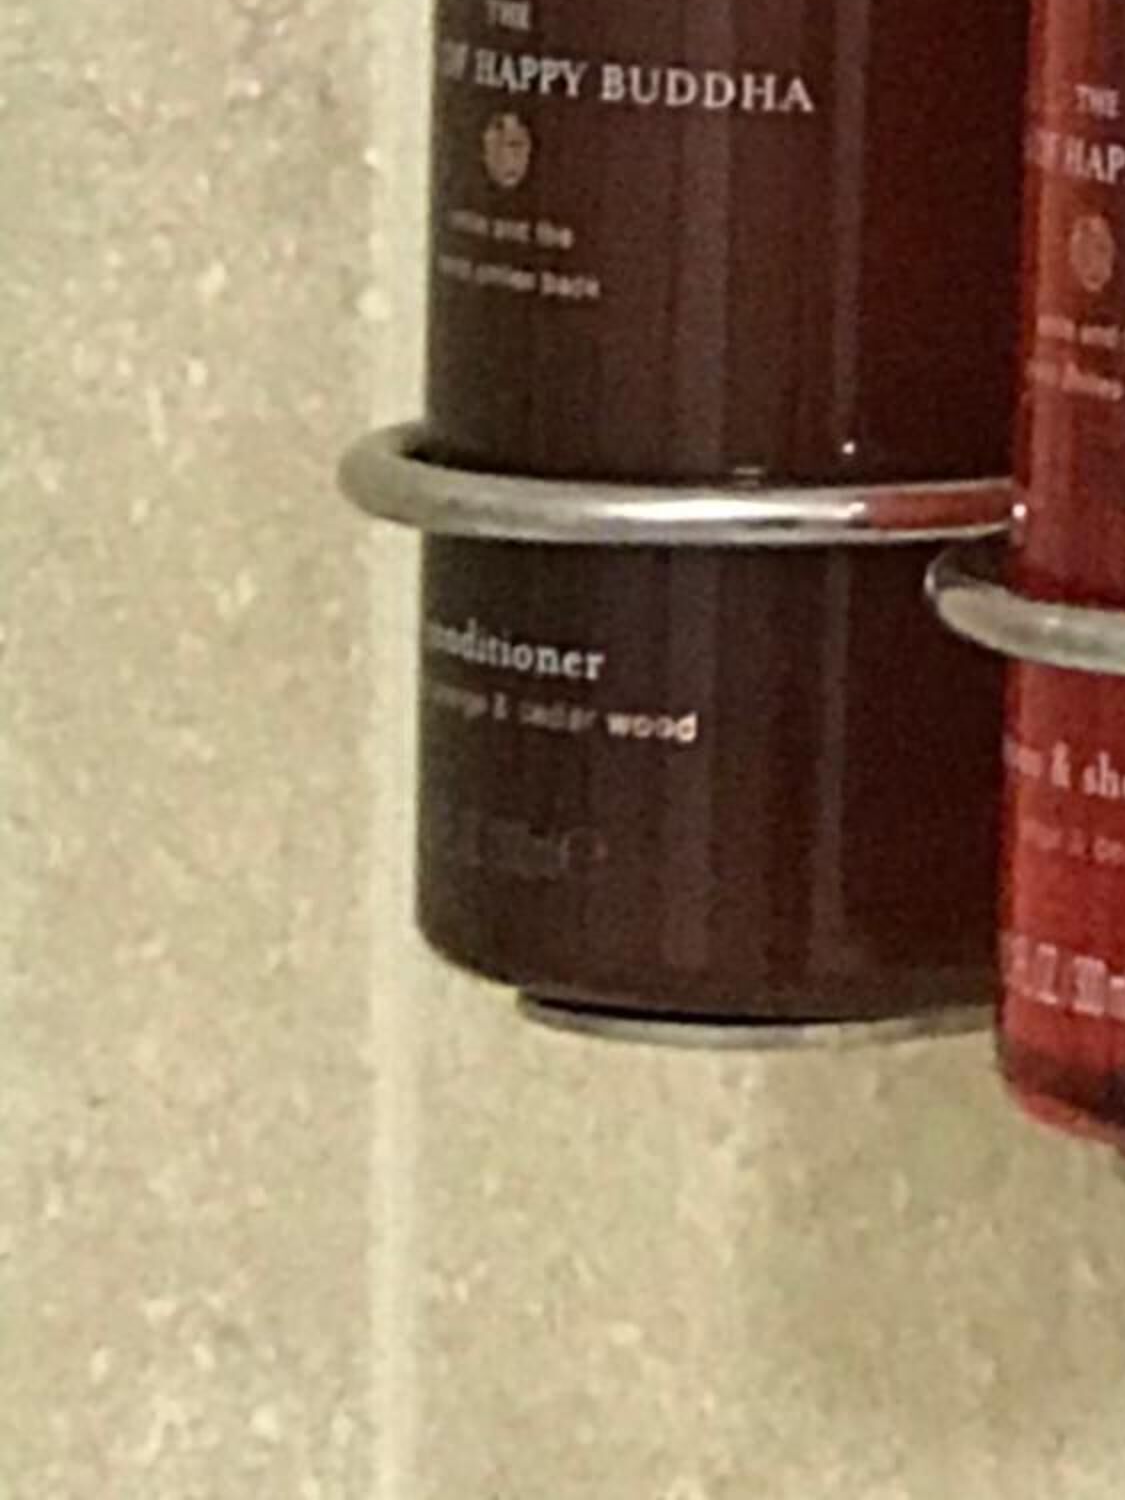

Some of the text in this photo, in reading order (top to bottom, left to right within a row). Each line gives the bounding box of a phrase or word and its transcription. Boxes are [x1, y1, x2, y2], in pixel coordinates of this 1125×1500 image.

[474, 48, 589, 98] HAPPY
[600, 62, 815, 114] BUDDHA
[606, 710, 698, 744] wood
